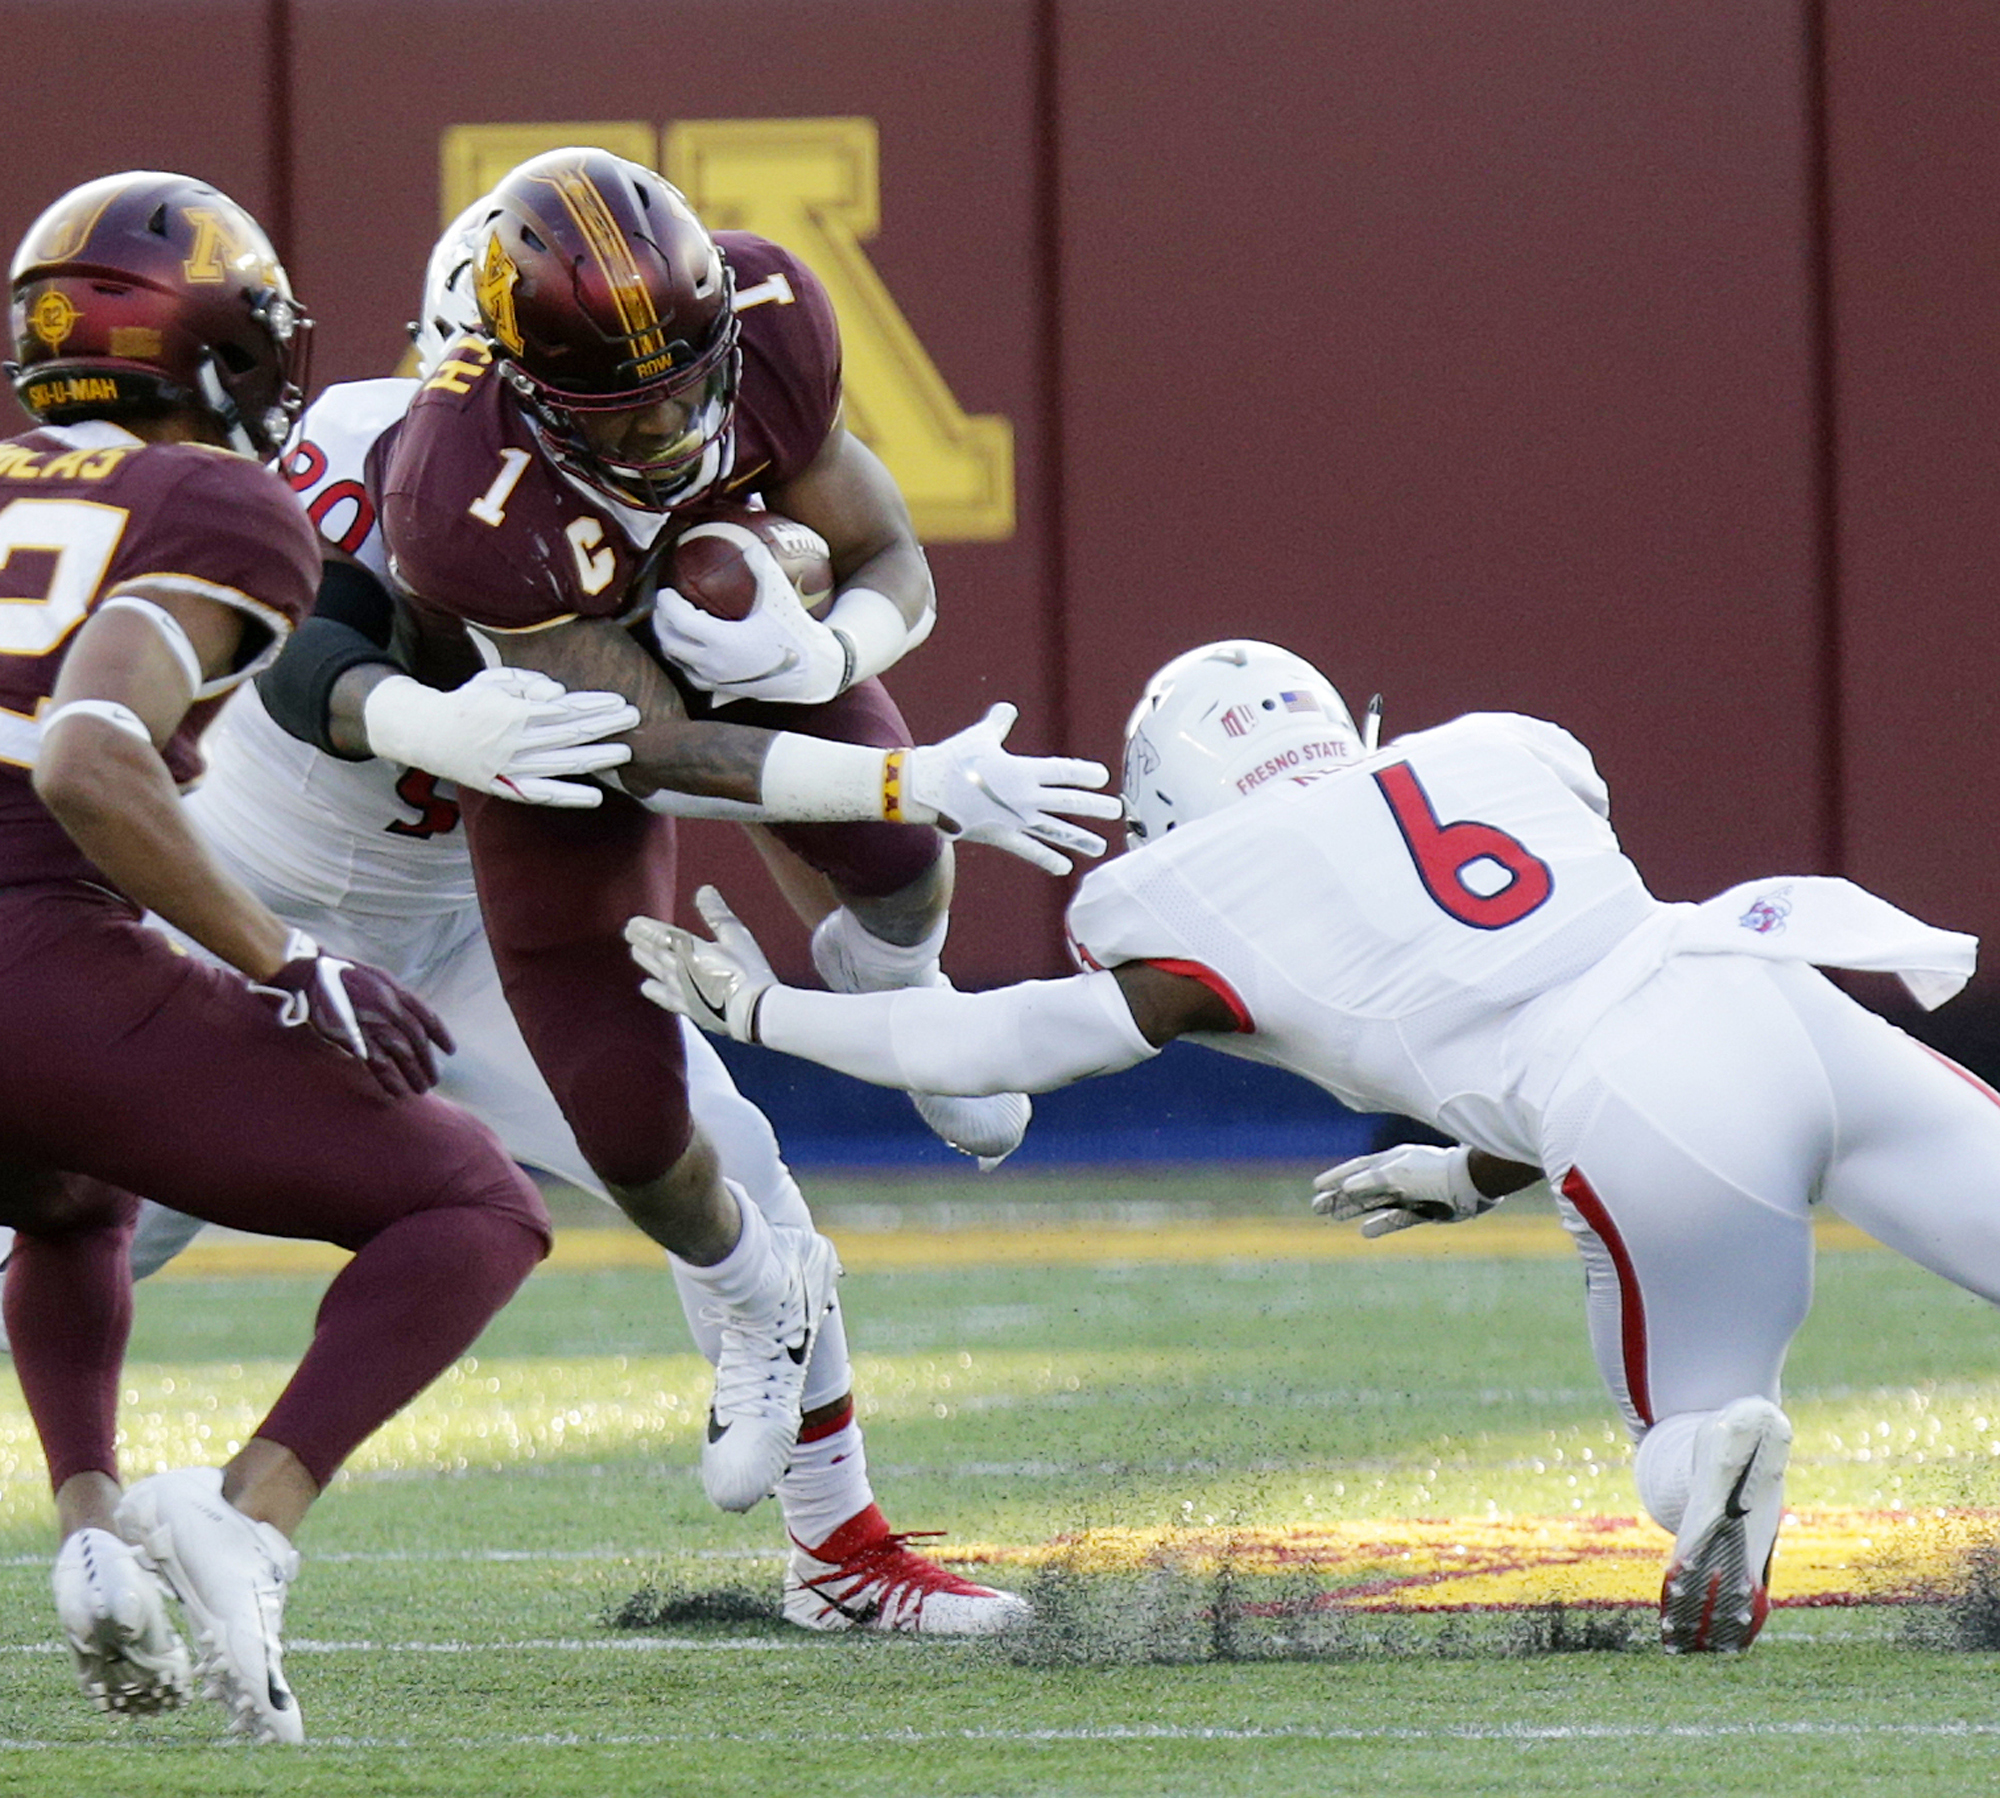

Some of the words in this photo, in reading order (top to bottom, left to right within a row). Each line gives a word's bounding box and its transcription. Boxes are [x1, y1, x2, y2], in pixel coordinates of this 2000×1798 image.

[730, 272, 796, 313] 1
[636, 352, 674, 379] ROW
[468, 447, 532, 527] 1
[565, 516, 616, 595] C
[1236, 749, 1300, 796] FRESNO
[1302, 740, 1347, 760] STATE
[1371, 759, 1555, 931] 6
